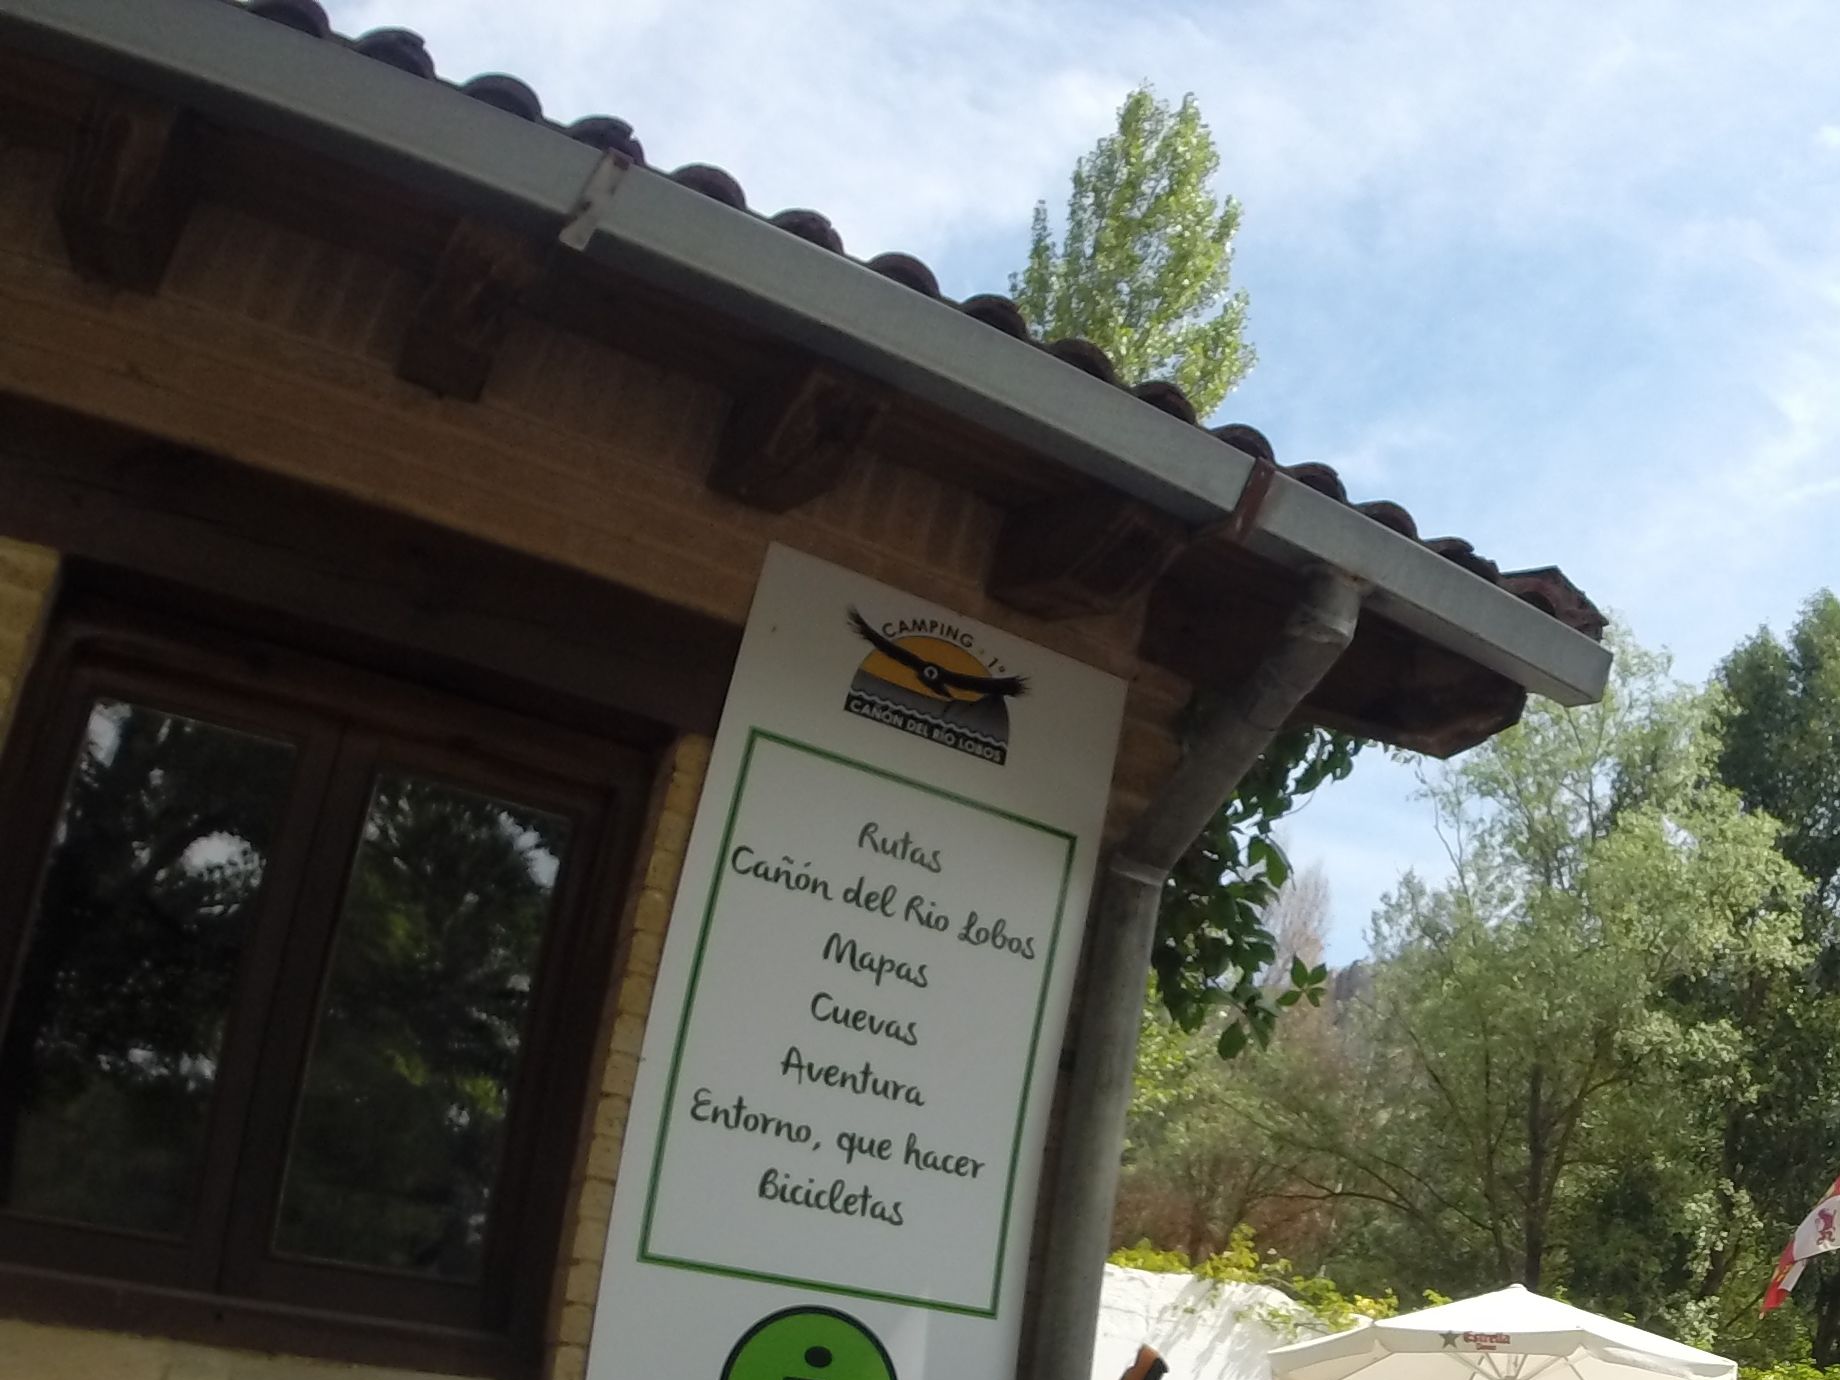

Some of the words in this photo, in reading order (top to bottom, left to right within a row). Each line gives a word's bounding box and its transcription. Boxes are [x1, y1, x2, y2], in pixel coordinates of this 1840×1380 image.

[881, 618, 974, 649] CAMPING
[906, 719, 930, 740] DEL
[958, 738, 1002, 762] LOBOS
[857, 821, 943, 874] Rutas
[731, 844, 834, 902] Cañón
[842, 875, 898, 918] del
[957, 909, 1036, 961] Lobos
[822, 931, 930, 989] Mapas
[810, 991, 920, 1047] Cuevas
[780, 1045, 926, 1108] Aventura
[689, 1087, 823, 1152] Entorno,
[836, 1129, 893, 1165] que
[903, 1132, 986, 1180] hacer
[757, 1167, 905, 1227] Bicicletas
